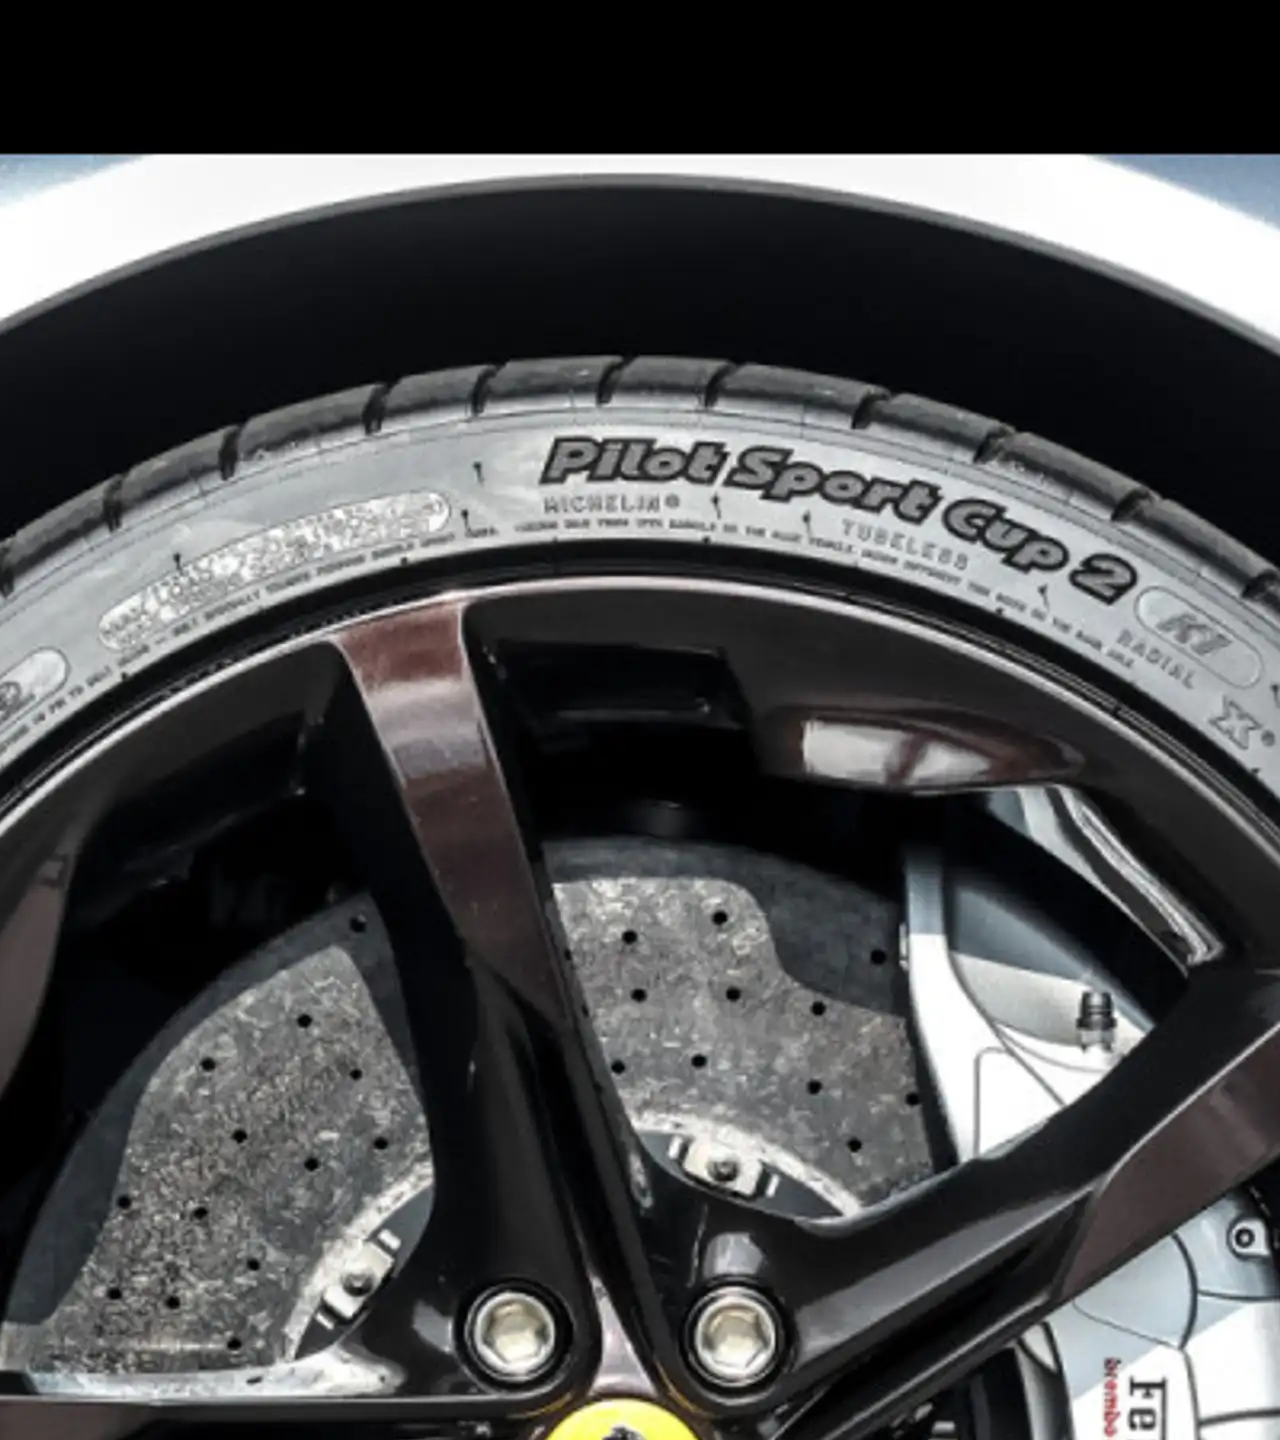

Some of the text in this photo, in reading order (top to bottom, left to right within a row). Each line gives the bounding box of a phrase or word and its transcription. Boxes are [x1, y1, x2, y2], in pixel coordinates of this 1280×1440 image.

[538, 434, 730, 485] Pilot
[723, 444, 944, 524] Sport
[942, 497, 1070, 573] Cup
[1069, 553, 1137, 605] 2
[841, 518, 970, 572] TUBELESS
[1116, 629, 1195, 690] RADIAL
[1102, 1357, 1122, 1437] brembo
